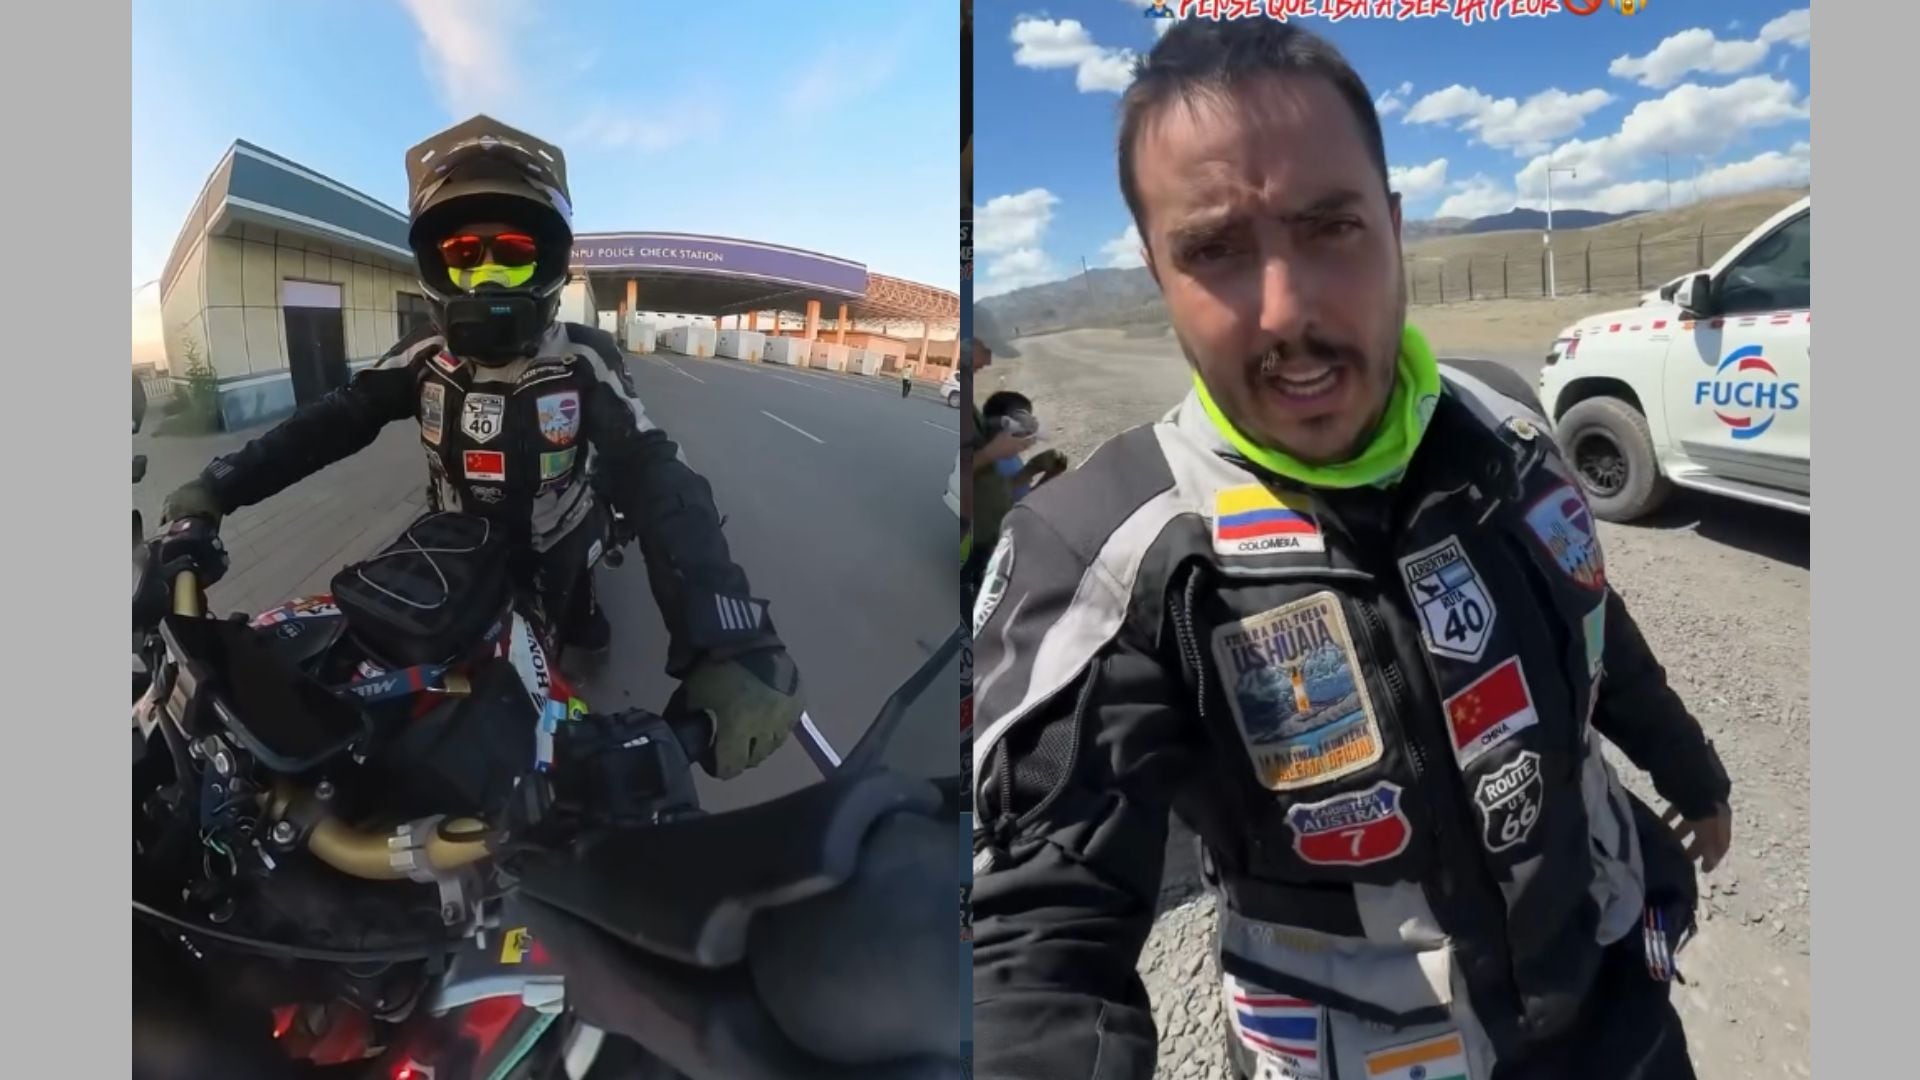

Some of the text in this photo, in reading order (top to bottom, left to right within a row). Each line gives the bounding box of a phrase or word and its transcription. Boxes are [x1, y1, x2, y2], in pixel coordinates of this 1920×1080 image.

[598, 247, 635, 258] POLICE
[640, 247, 677, 259] CHECK
[679, 249, 724, 262] STATION
[1694, 380, 1801, 411] FUCHS
[469, 418, 493, 435] 40
[1238, 536, 1300, 552] COLOMBIA
[1444, 598, 1485, 643] 40
[1230, 618, 1336, 674] USHUAIA
[1480, 722, 1511, 746] CHINA
[1484, 758, 1534, 802] ROUTE
[1303, 801, 1392, 833] AUSTRAL
[1500, 798, 1537, 842] 66
[1339, 828, 1365, 857] 7
